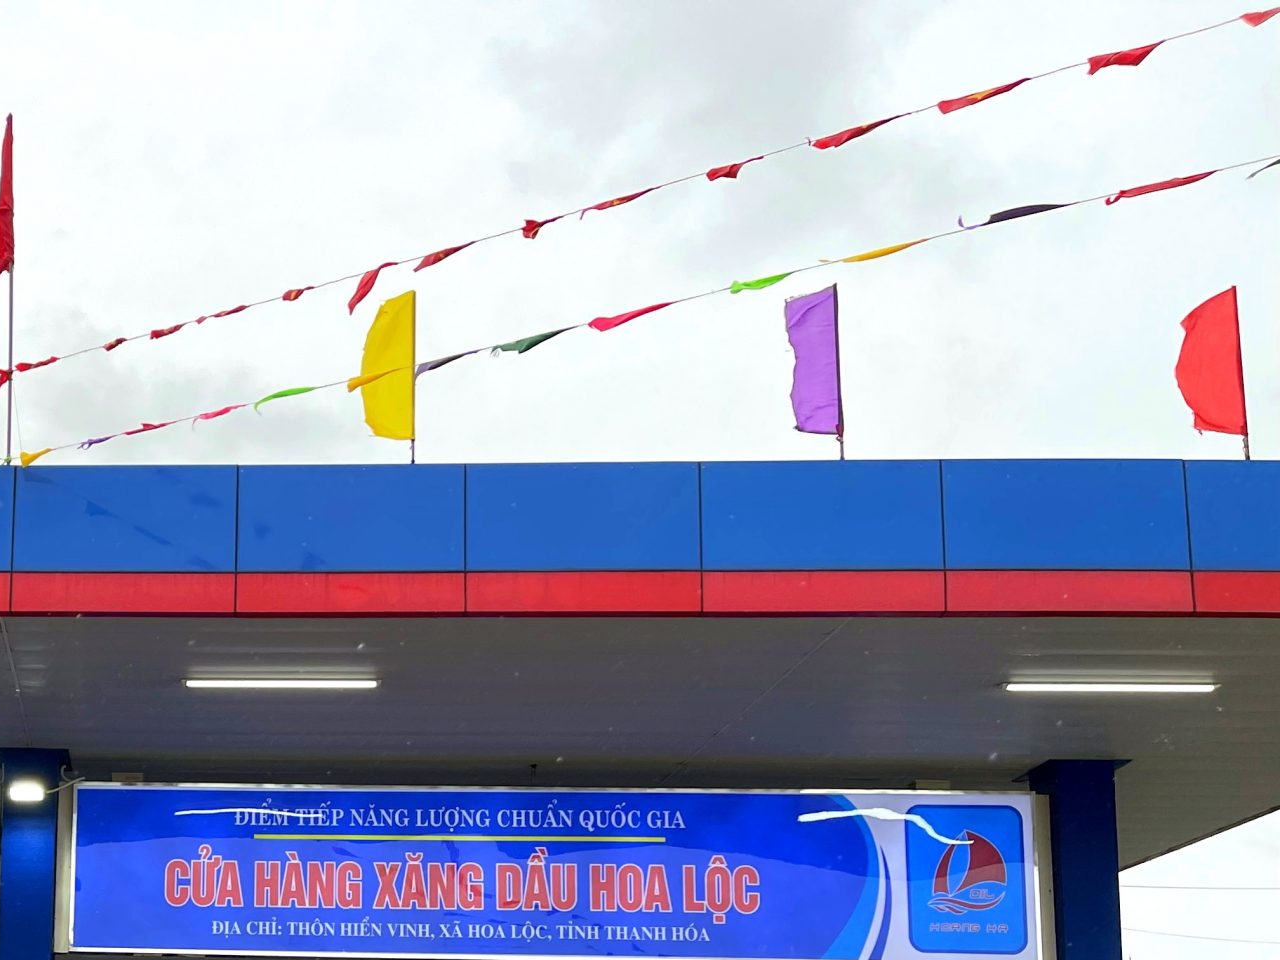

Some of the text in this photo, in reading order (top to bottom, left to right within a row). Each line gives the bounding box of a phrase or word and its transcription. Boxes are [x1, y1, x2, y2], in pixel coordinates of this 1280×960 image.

[234, 798, 686, 833] ĐIỂM TIẾP NĂNG LƯỢNG CHUẨN QUỐC GIA
[164, 844, 761, 925] CỬA HÀNG XĂNG DẦU HOA LỘC
[970, 889, 995, 899] OIL
[212, 915, 710, 944] ĐỊA CHỈ: THÔN HIỂN VINH, XÃ HOA LỘC, TỈNH THANH HÓA
[929, 922, 1009, 933] HOANG HA
